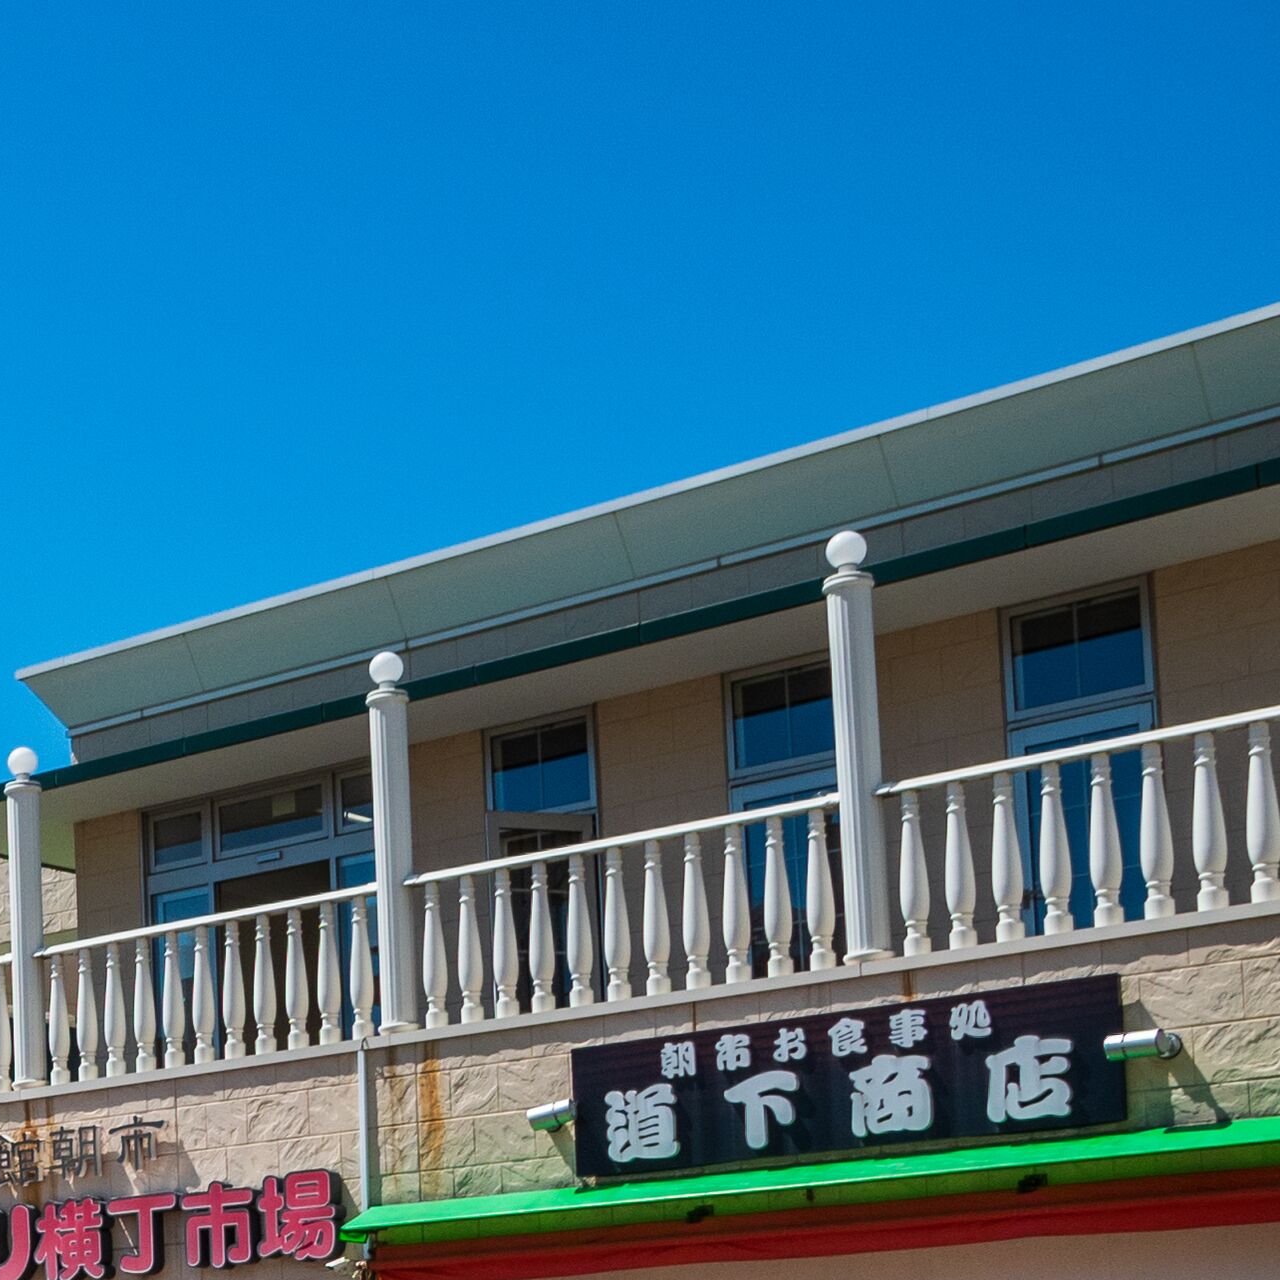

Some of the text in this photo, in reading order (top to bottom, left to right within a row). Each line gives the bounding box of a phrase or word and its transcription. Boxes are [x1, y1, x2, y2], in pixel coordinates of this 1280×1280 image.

[660, 999, 993, 1080] 朝市お食事処
[603, 1034, 1074, 1163] 道下商店
